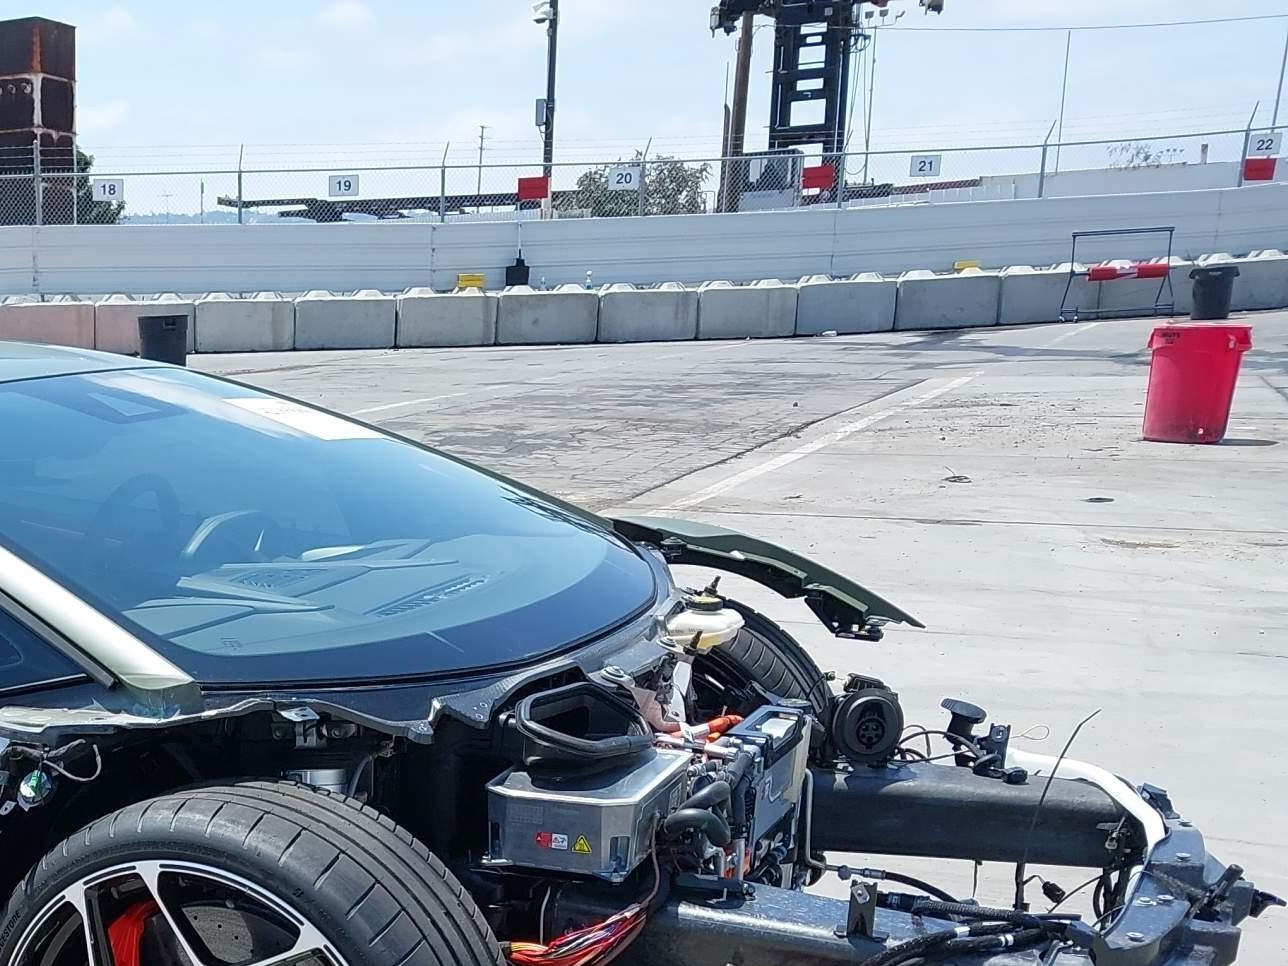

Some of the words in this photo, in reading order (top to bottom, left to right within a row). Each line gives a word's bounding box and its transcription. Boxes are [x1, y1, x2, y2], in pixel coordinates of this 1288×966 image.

[1256, 138, 1274, 151] 22
[918, 160, 933, 172] 21
[616, 172, 632, 185] 20
[100, 183, 117, 196] 18
[336, 179, 352, 192] 19
